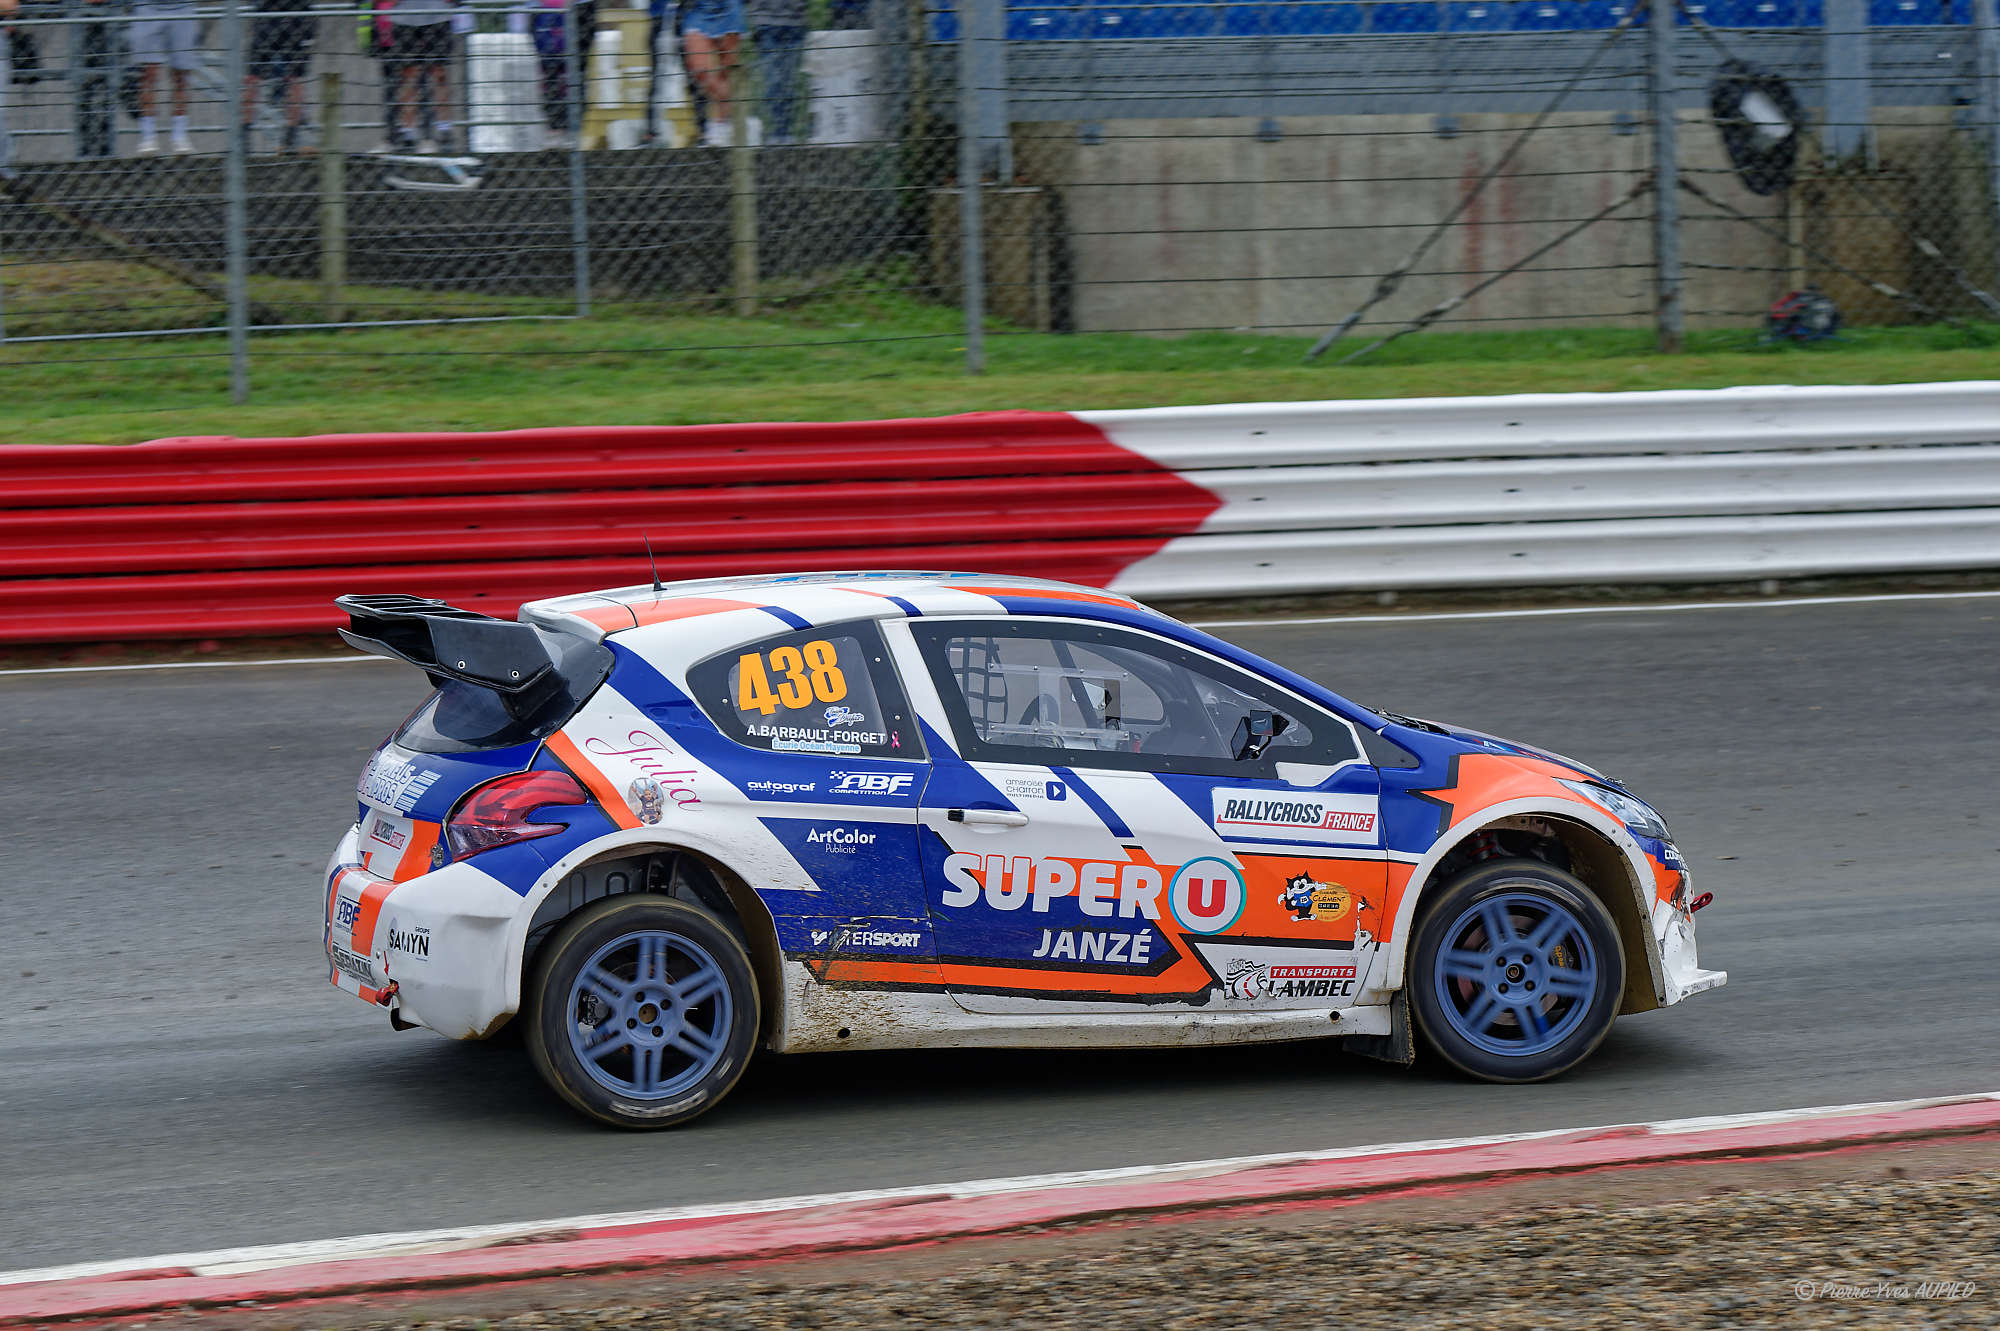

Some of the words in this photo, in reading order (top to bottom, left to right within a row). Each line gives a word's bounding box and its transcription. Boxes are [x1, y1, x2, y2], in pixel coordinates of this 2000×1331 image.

[739, 640, 847, 715] 438
[747, 724, 885, 744] A.BARBAULT-FORGET
[826, 742, 860, 754] Mayenne
[585, 729, 703, 811] Julia
[747, 781, 816, 793] autograf
[834, 775, 914, 796] ABF
[1224, 799, 1323, 824] RALLYCROSS
[1326, 812, 1373, 831] FRANCE
[807, 828, 876, 844] ArtColor
[825, 843, 856, 854] Publicité
[942, 853, 1162, 920] SUPER
[1187, 877, 1227, 918] U
[337, 901, 361, 929] ABF
[415, 926, 430, 935] GROUPE
[1033, 929, 1152, 964] JANZÉ
[1272, 967, 1355, 977] TRANSPORTS
[1268, 979, 1356, 998] LAMBEC
